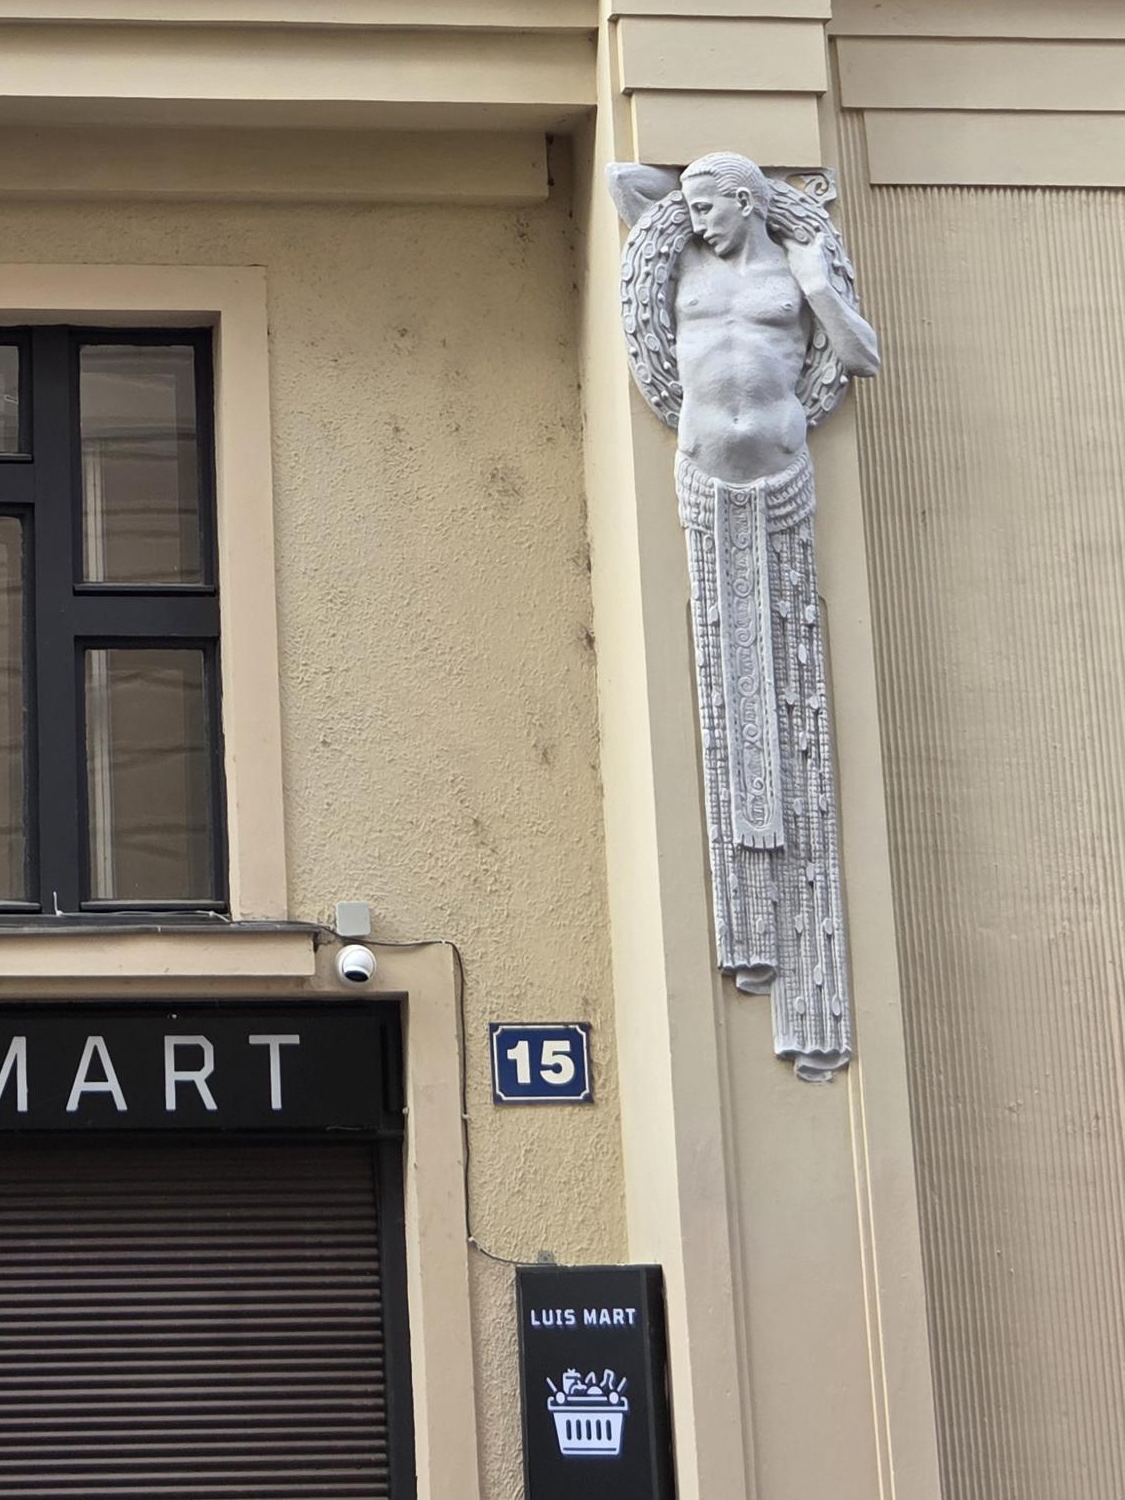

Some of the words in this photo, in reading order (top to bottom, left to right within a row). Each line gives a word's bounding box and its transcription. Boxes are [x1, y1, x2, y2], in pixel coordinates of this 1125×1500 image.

[506, 1039, 576, 1086] 15
[530, 1308, 577, 1327] LUIS
[583, 1307, 637, 1326] MART
